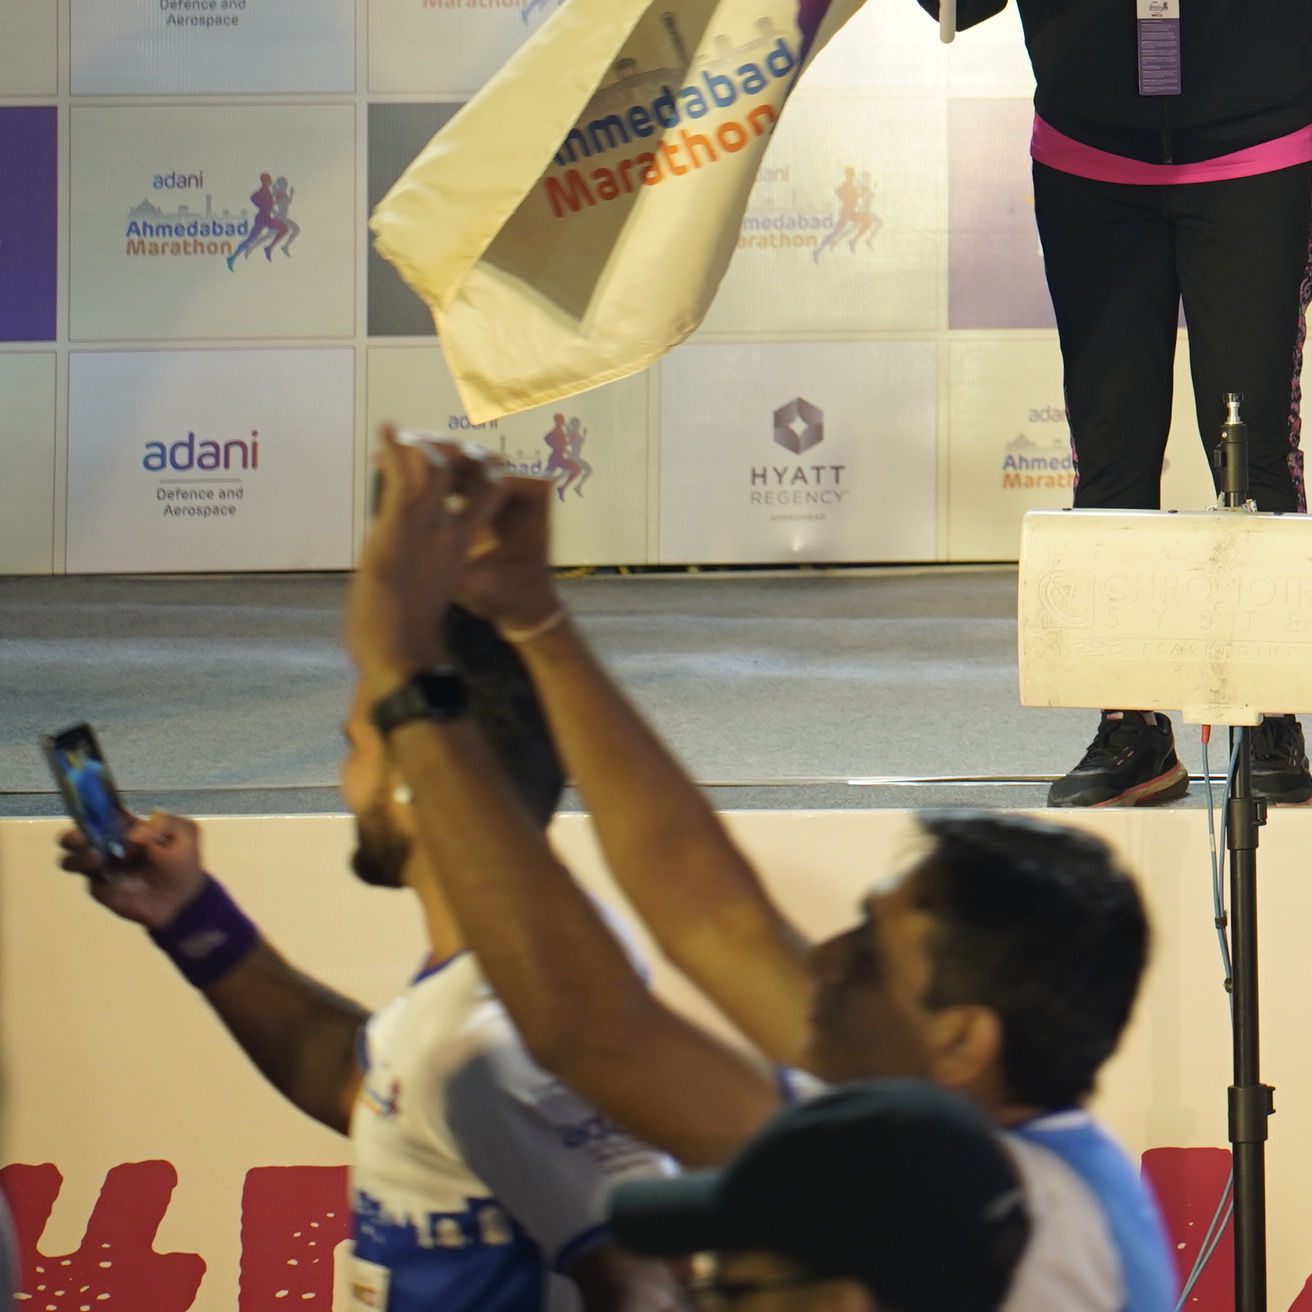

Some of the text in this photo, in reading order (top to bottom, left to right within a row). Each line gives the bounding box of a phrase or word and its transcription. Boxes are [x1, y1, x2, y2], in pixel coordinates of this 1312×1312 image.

[167, 13, 239, 29] Aerospace
[543, 104, 777, 218] Marathon
[153, 172, 203, 190] adani
[127, 220, 248, 239] Ahmedabad
[743, 214, 833, 230] medabad
[127, 239, 233, 257] Marathon
[738, 233, 818, 249] arathon
[143, 431, 259, 472] adani
[1003, 454, 1073, 470] Ahmed
[752, 465, 845, 485] HYATT
[156, 487, 243, 502] Defence and
[751, 490, 849, 505] REGENCY
[163, 503, 236, 518] Aerospace
[1141, 643, 1296, 658] FLASHPOINT
